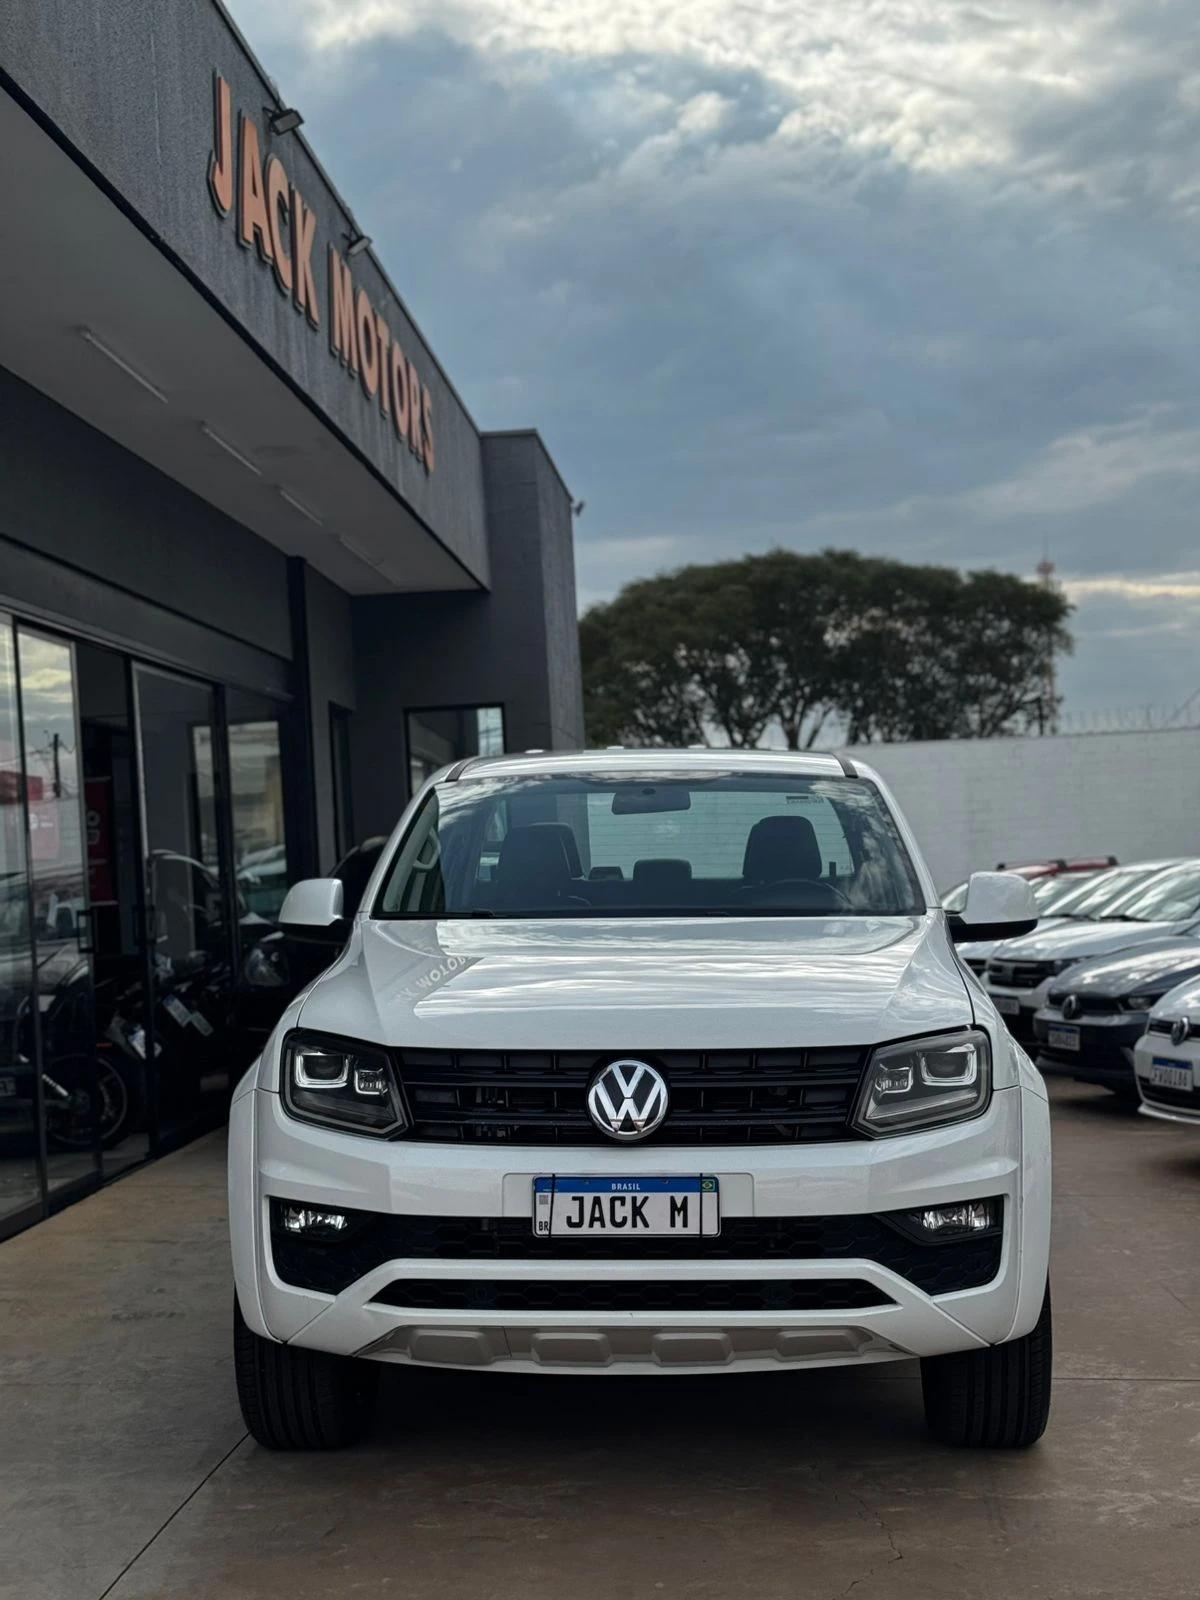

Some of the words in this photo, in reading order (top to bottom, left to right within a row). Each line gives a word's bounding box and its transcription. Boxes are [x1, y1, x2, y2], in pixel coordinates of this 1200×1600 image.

[208, 71, 320, 330] JACK
[328, 243, 435, 475] MOTORS
[593, 1064, 664, 1132] VW
[611, 1183, 641, 1191] BRASIL
[538, 1220, 549, 1232] BR
[566, 1195, 650, 1229] JACK
[669, 1195, 689, 1229] M
